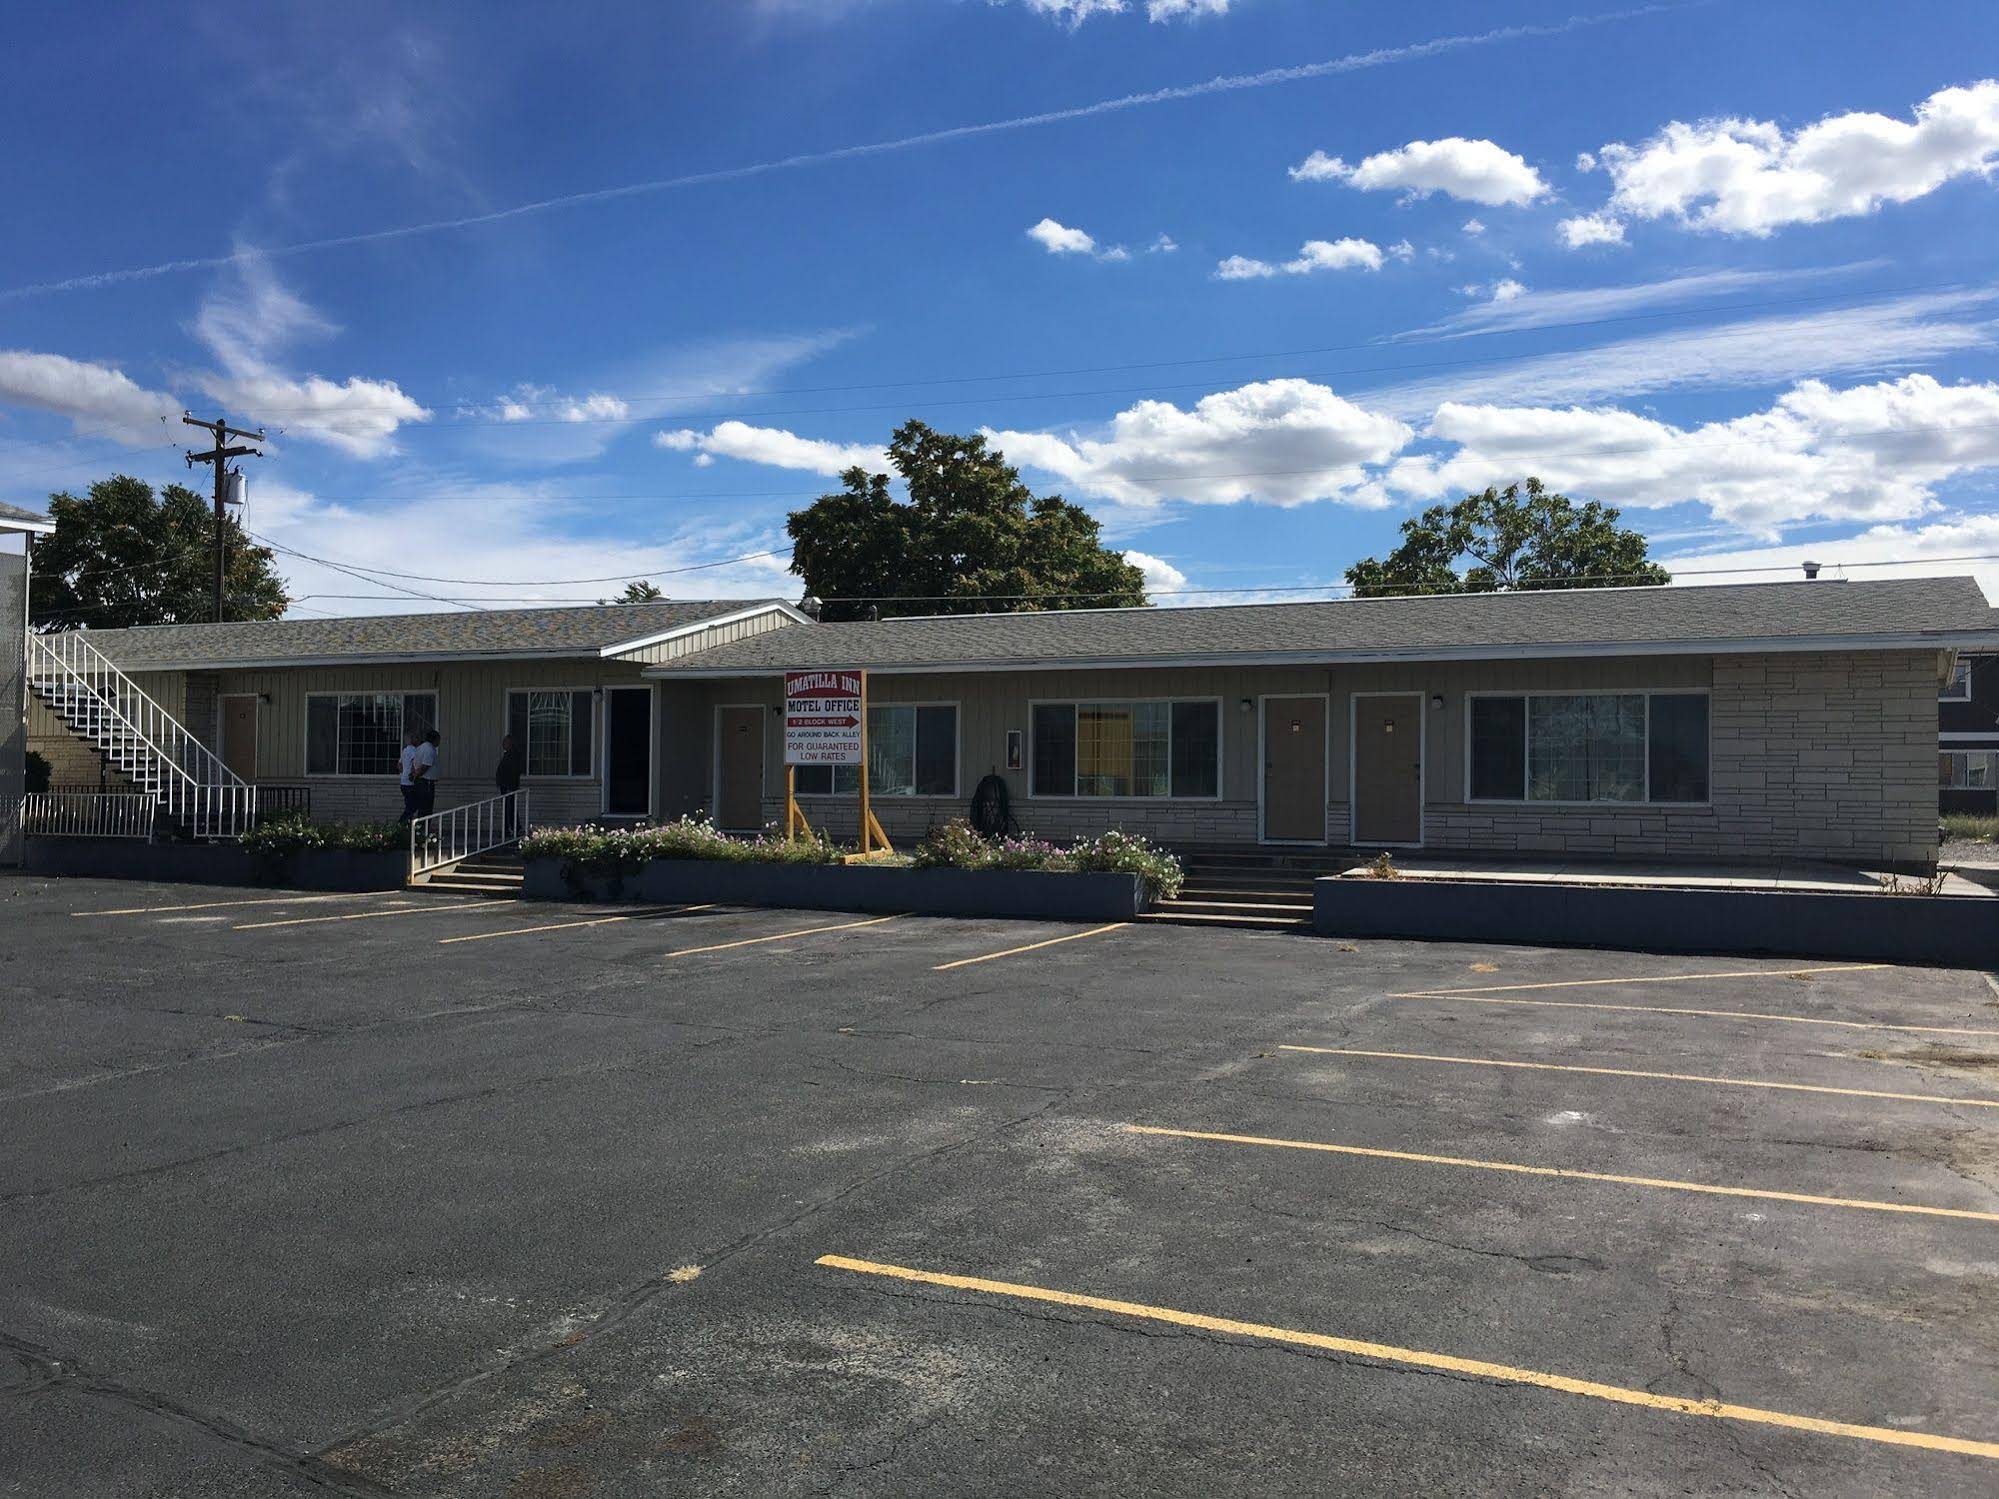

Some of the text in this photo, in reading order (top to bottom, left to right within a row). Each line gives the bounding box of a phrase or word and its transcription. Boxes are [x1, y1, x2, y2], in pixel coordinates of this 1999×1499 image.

[787, 673, 860, 696] UMATILLA INN
[788, 700, 859, 712] MOTEL OFFICE
